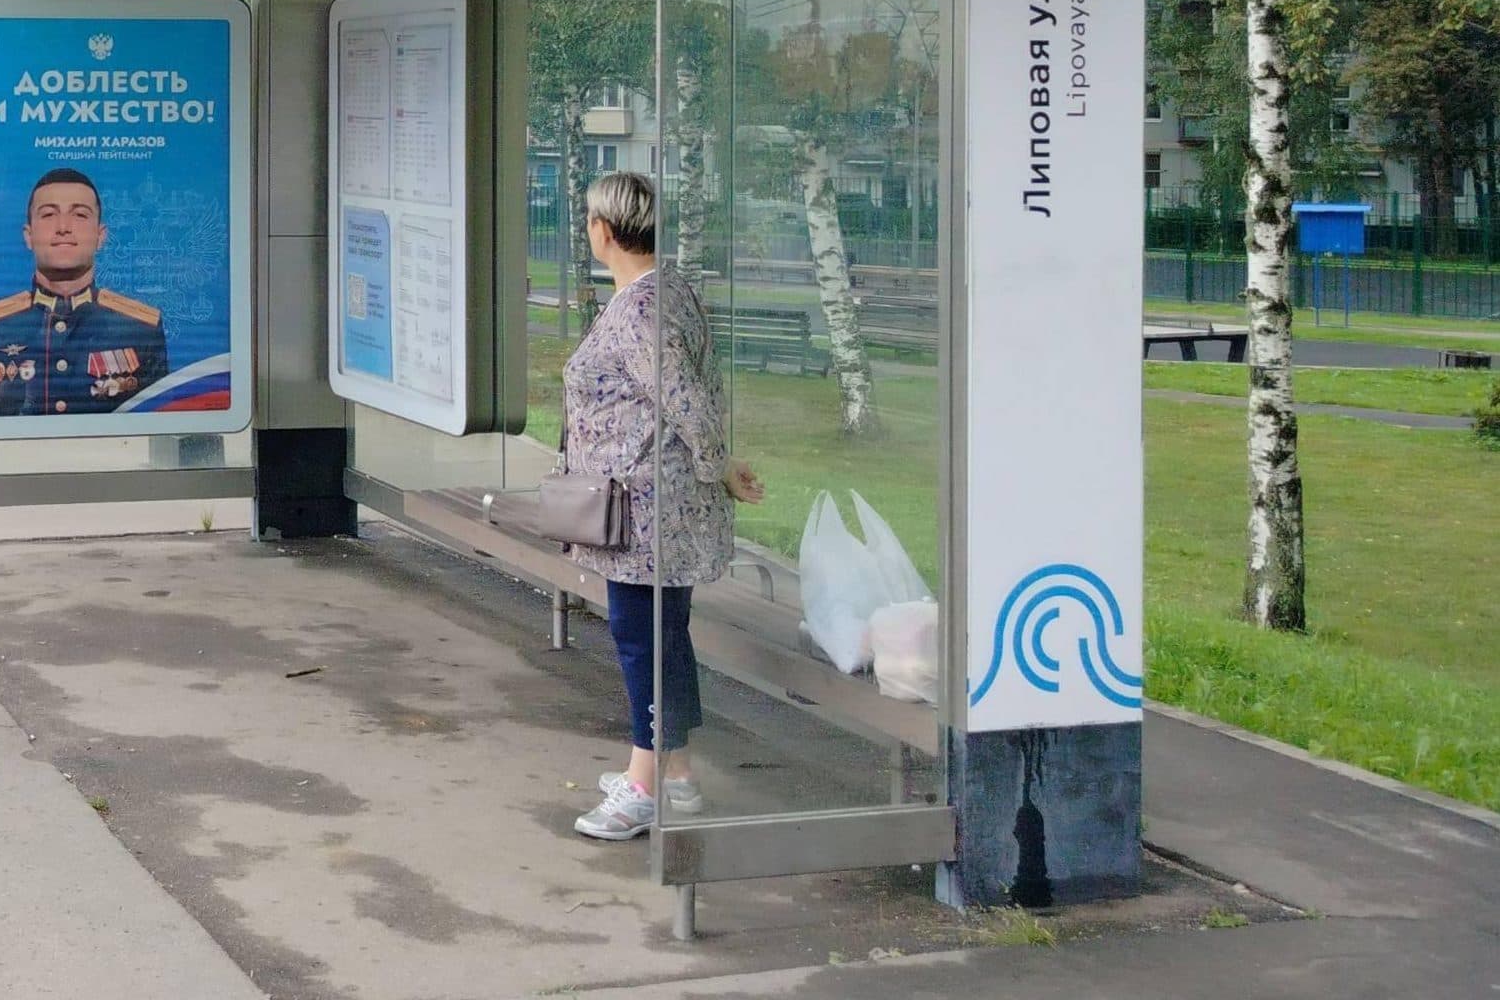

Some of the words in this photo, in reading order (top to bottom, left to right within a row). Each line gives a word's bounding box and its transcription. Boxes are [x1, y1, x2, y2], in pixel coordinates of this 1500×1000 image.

[14, 70, 188, 96] ДОБЛЕСТЬ
[21, 100, 215, 123] МУЖЕСТВО!
[1023, 40, 1051, 218] Липовая
[34, 136, 97, 148] МИХАИЛ
[101, 136, 166, 147] ХАРАЗОВ
[47, 150, 96, 160] СТАРШИЙ
[98, 150, 153, 160] ЛЕЙТЕНАНТ
